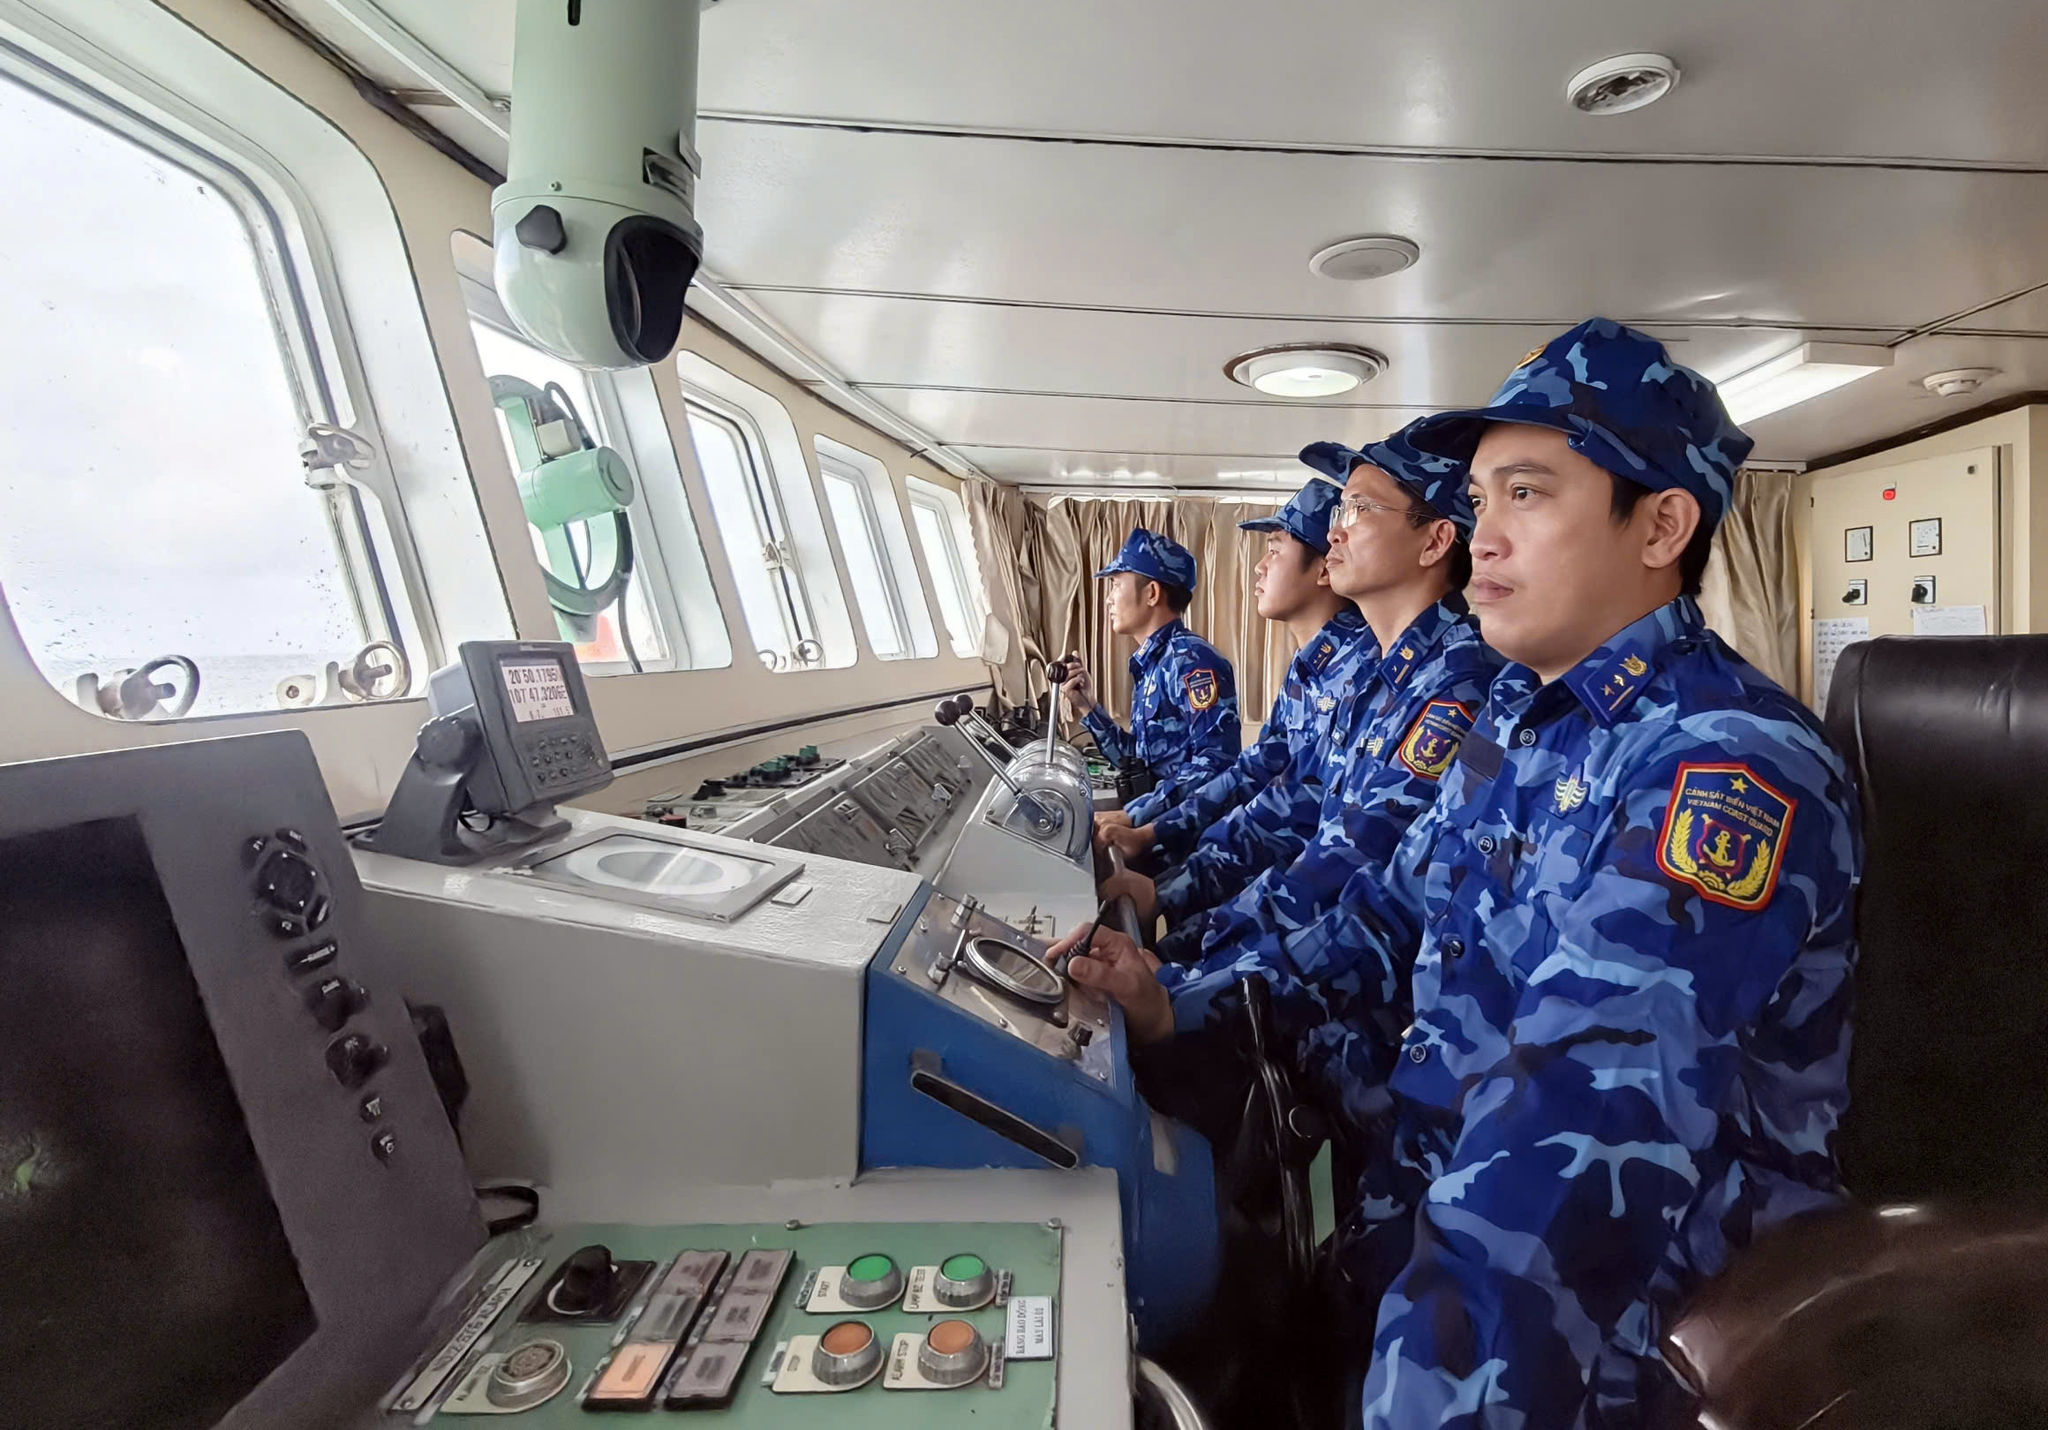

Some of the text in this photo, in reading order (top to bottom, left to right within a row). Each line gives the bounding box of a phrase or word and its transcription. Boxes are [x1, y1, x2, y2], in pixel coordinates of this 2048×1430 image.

[1687, 798, 1773, 837] VIETNAM COAST GUARD
